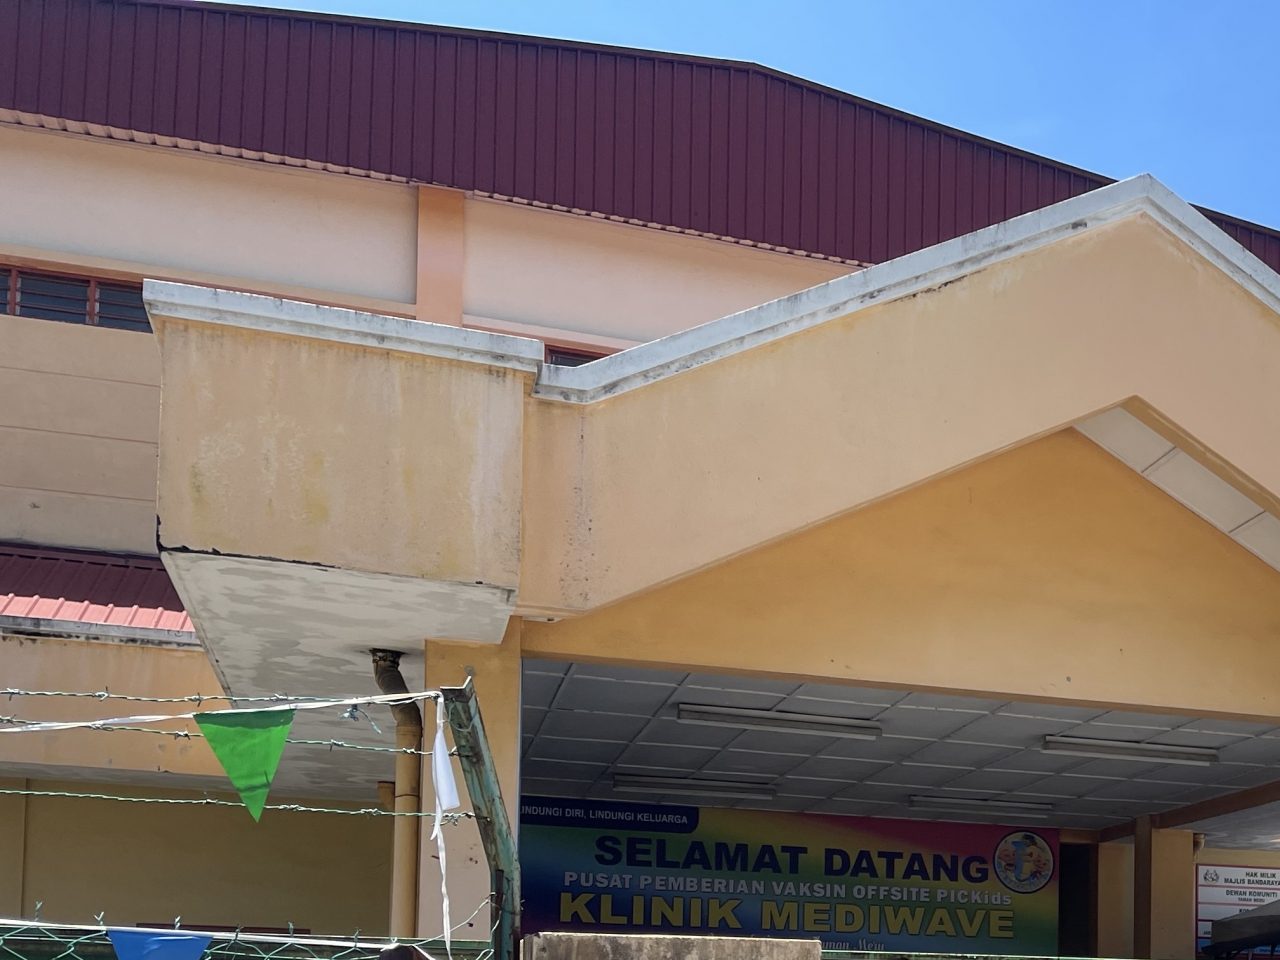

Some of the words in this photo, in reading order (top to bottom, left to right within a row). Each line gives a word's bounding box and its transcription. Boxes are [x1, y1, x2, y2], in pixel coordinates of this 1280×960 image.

[565, 808, 587, 819] DIRI,
[589, 810, 635, 821] LINDUNGI
[637, 813, 689, 825] KELUARGA
[594, 835, 808, 876] SELAMAT
[823, 847, 990, 883] DATANG
[1223, 877, 1246, 886] MAJLIS
[1245, 871, 1258, 879] HAK
[563, 871, 634, 889] PUSAT
[639, 874, 766, 896] PEMBERIAN
[771, 880, 847, 899] VAKSIN
[853, 884, 931, 903] OFFSITE
[1225, 889, 1247, 897] DEWAN
[1248, 890, 1278, 899] KOMUNITI
[559, 891, 743, 930] KLINIK
[760, 898, 1016, 939] MEDIWAVE
